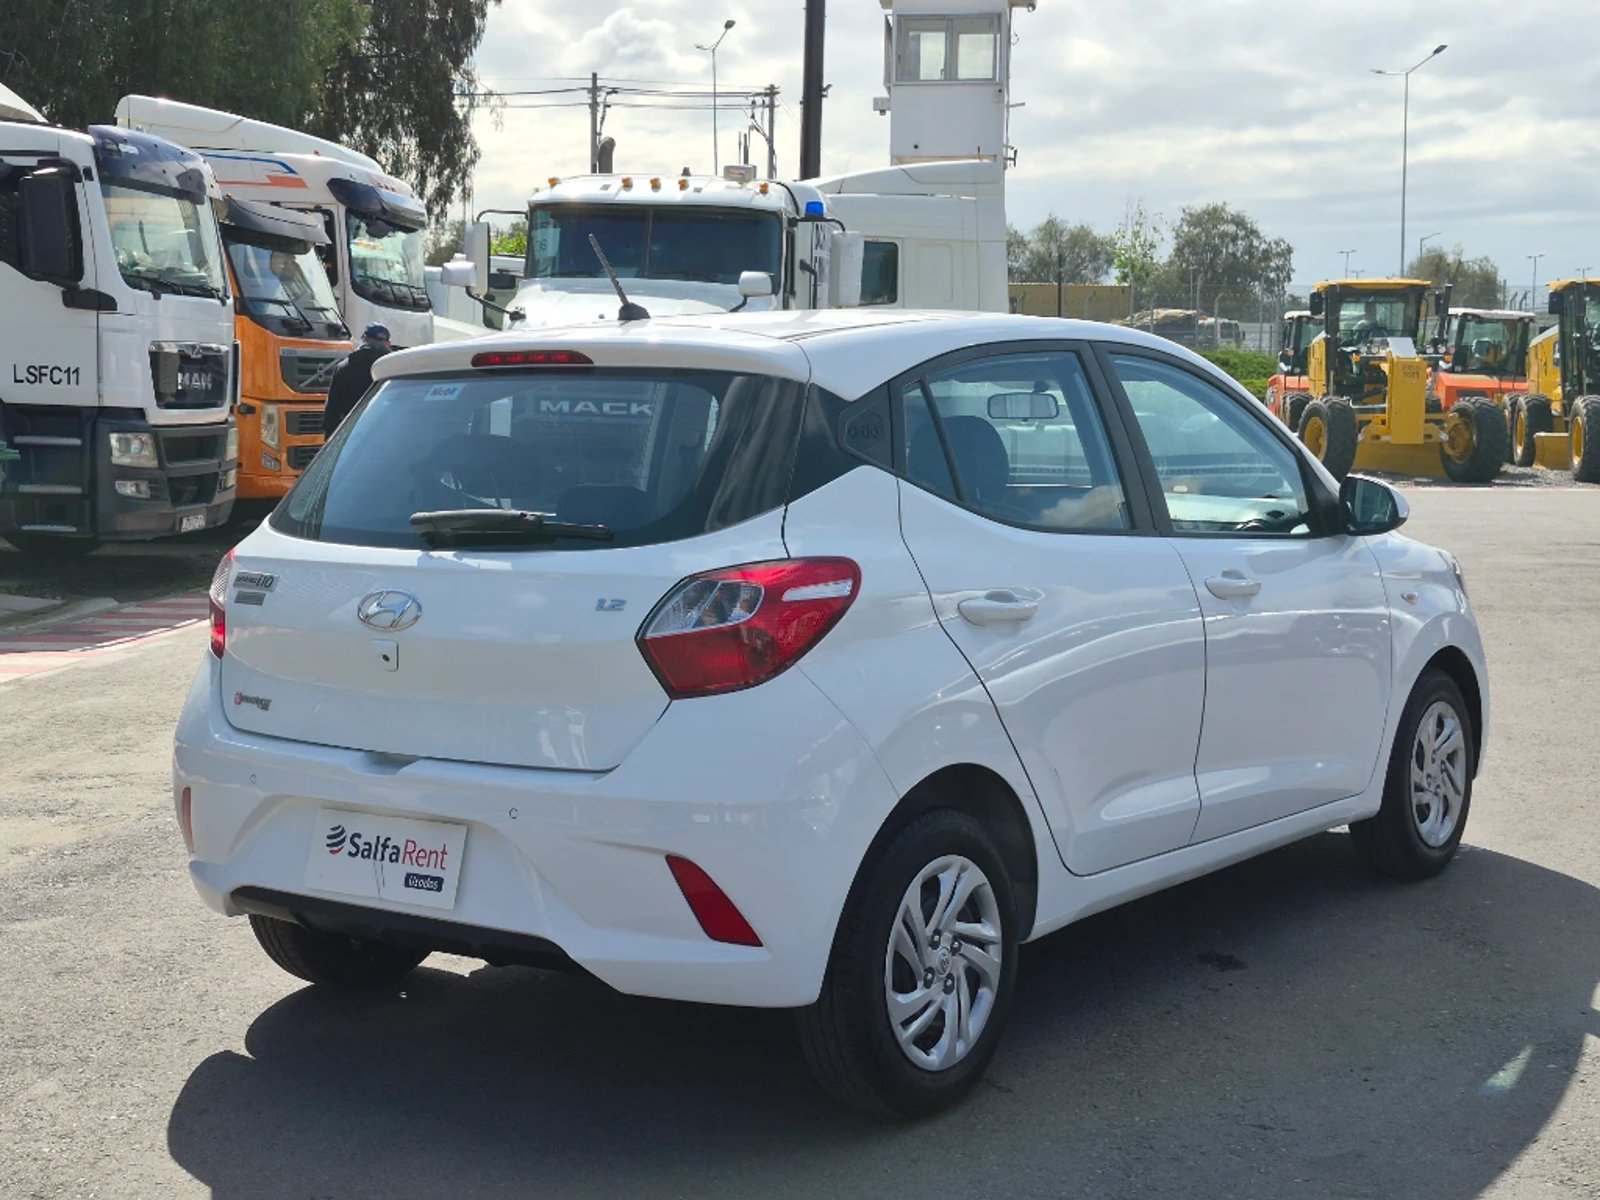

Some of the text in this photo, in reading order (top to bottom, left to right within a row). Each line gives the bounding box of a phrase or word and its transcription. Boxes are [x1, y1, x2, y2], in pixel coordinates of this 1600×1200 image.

[13, 364, 80, 386] LSFC11
[177, 372, 213, 390] MAN
[540, 399, 656, 416] MACK
[347, 832, 449, 871] SalfaRent
